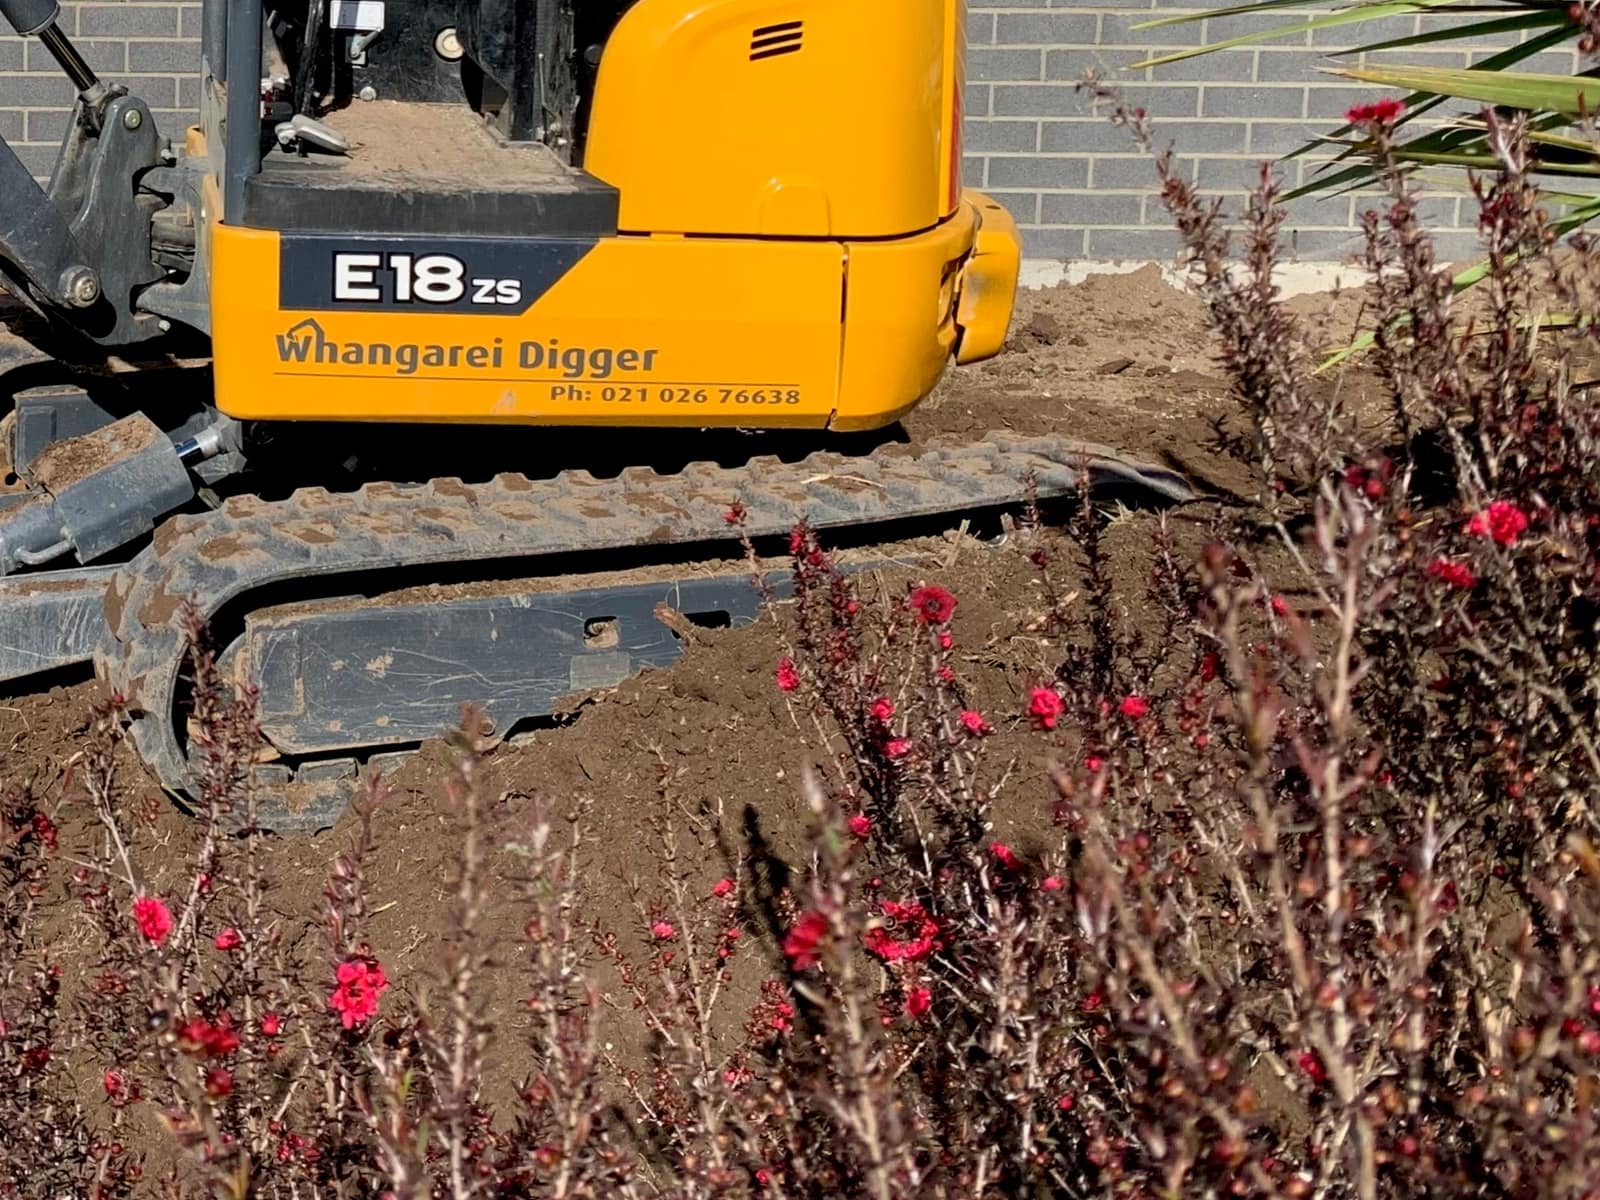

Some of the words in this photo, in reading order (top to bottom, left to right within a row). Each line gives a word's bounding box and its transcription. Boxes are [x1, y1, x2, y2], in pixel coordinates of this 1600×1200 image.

[334, 253, 465, 303] E18
[275, 317, 503, 375] Whangarei
[518, 338, 659, 379] Digger
[550, 385, 592, 402] Ph:
[601, 386, 648, 403] 021
[659, 387, 708, 404] 026
[718, 388, 801, 405] 76638
